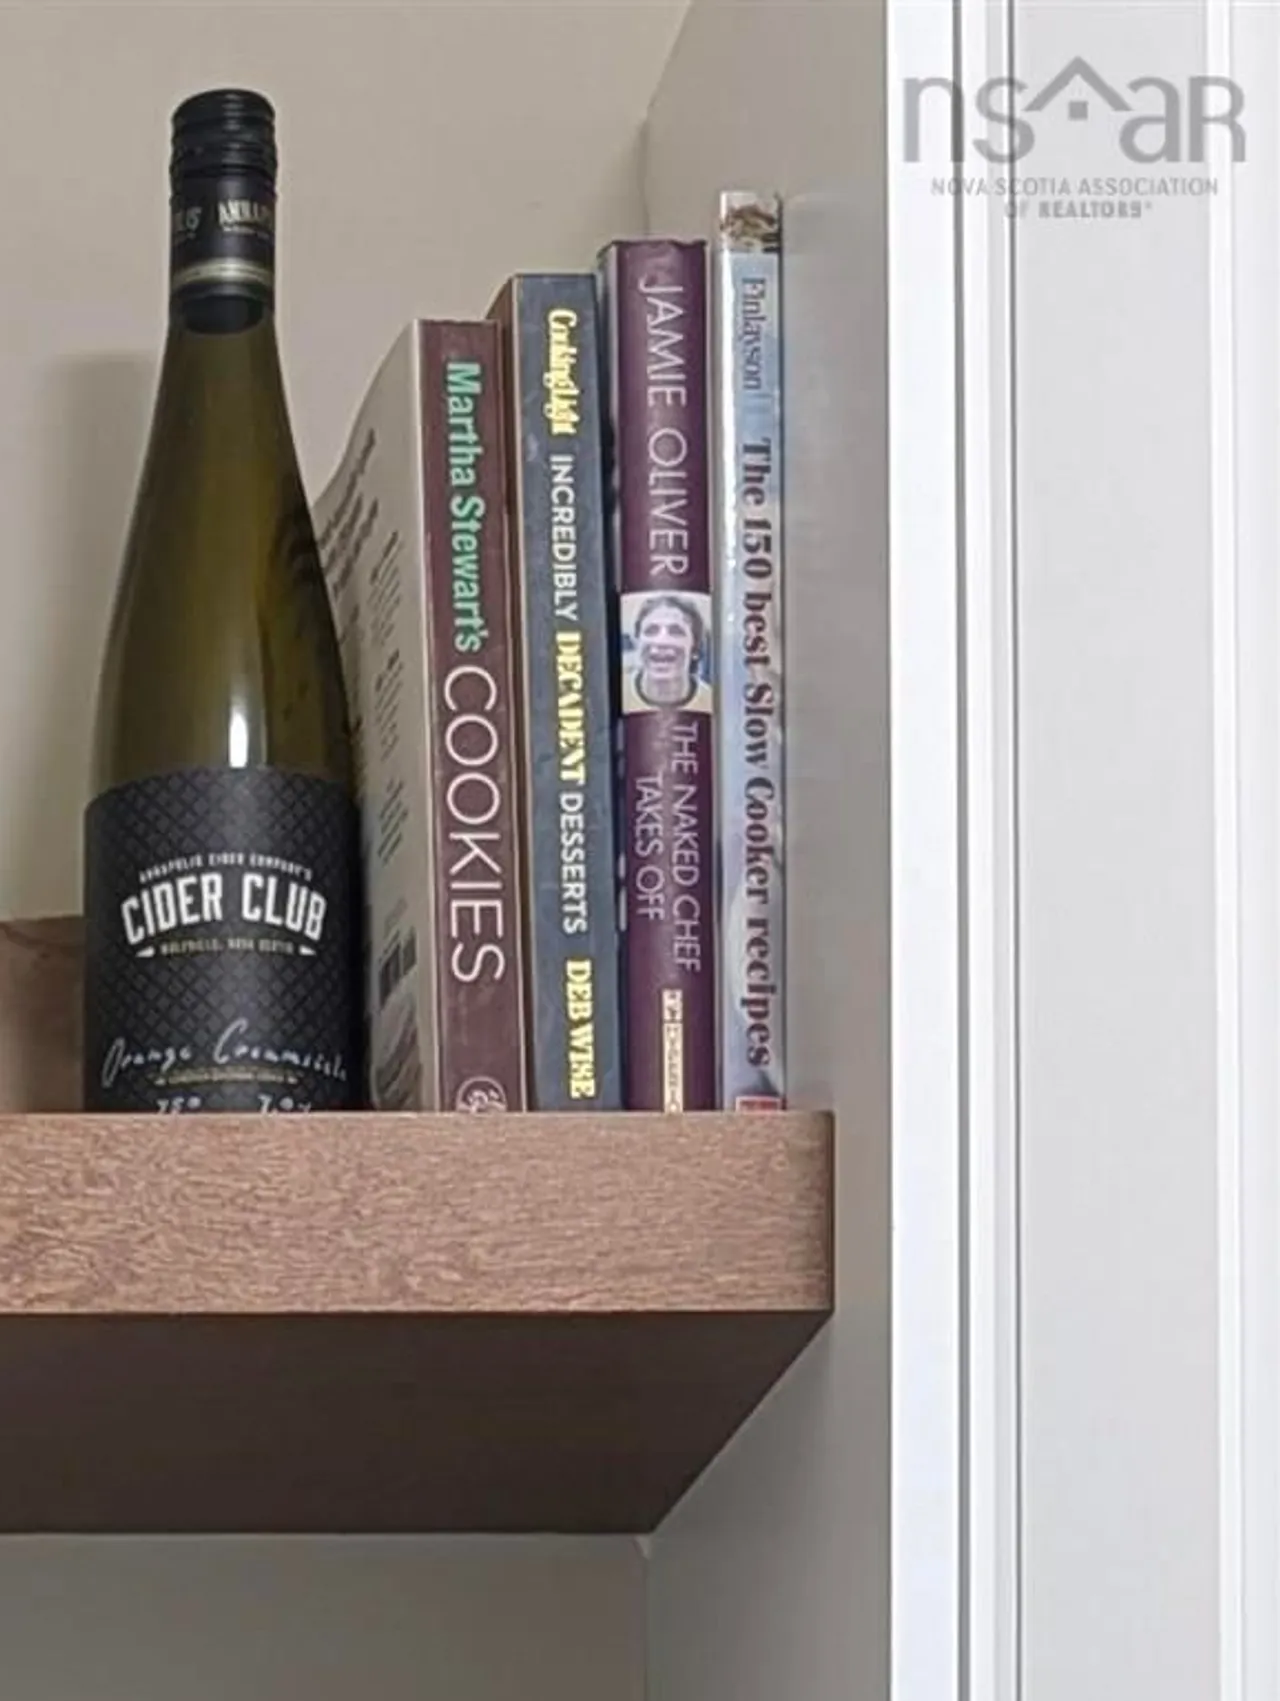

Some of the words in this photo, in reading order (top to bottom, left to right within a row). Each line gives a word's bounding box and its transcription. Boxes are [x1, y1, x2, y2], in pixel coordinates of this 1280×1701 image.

[639, 277, 688, 408] JAMIE
[740, 276, 768, 392] Finlayson
[446, 362, 484, 486] Martha
[741, 437, 772, 508] The
[549, 454, 579, 623] INCREDIBLY
[646, 428, 691, 577] OLIVER
[741, 517, 773, 579] 150
[450, 496, 488, 654] Stewart's
[741, 585, 772, 666] best
[555, 630, 587, 786] DECADENT
[669, 721, 700, 775] THE
[743, 682, 774, 771] Slow
[443, 665, 506, 982] COOKIES
[559, 790, 588, 935] DESSERTS
[634, 771, 665, 861] TAKES
[669, 785, 701, 887] NAKED
[743, 775, 775, 909] Cooker
[121, 871, 223, 945] CIDER
[241, 871, 328, 942] CLUB
[635, 867, 666, 922] OFF
[670, 892, 702, 972] CHEF
[565, 958, 593, 1018] DEB
[740, 915, 777, 1068] recipes
[568, 1018, 597, 1099] WISE
